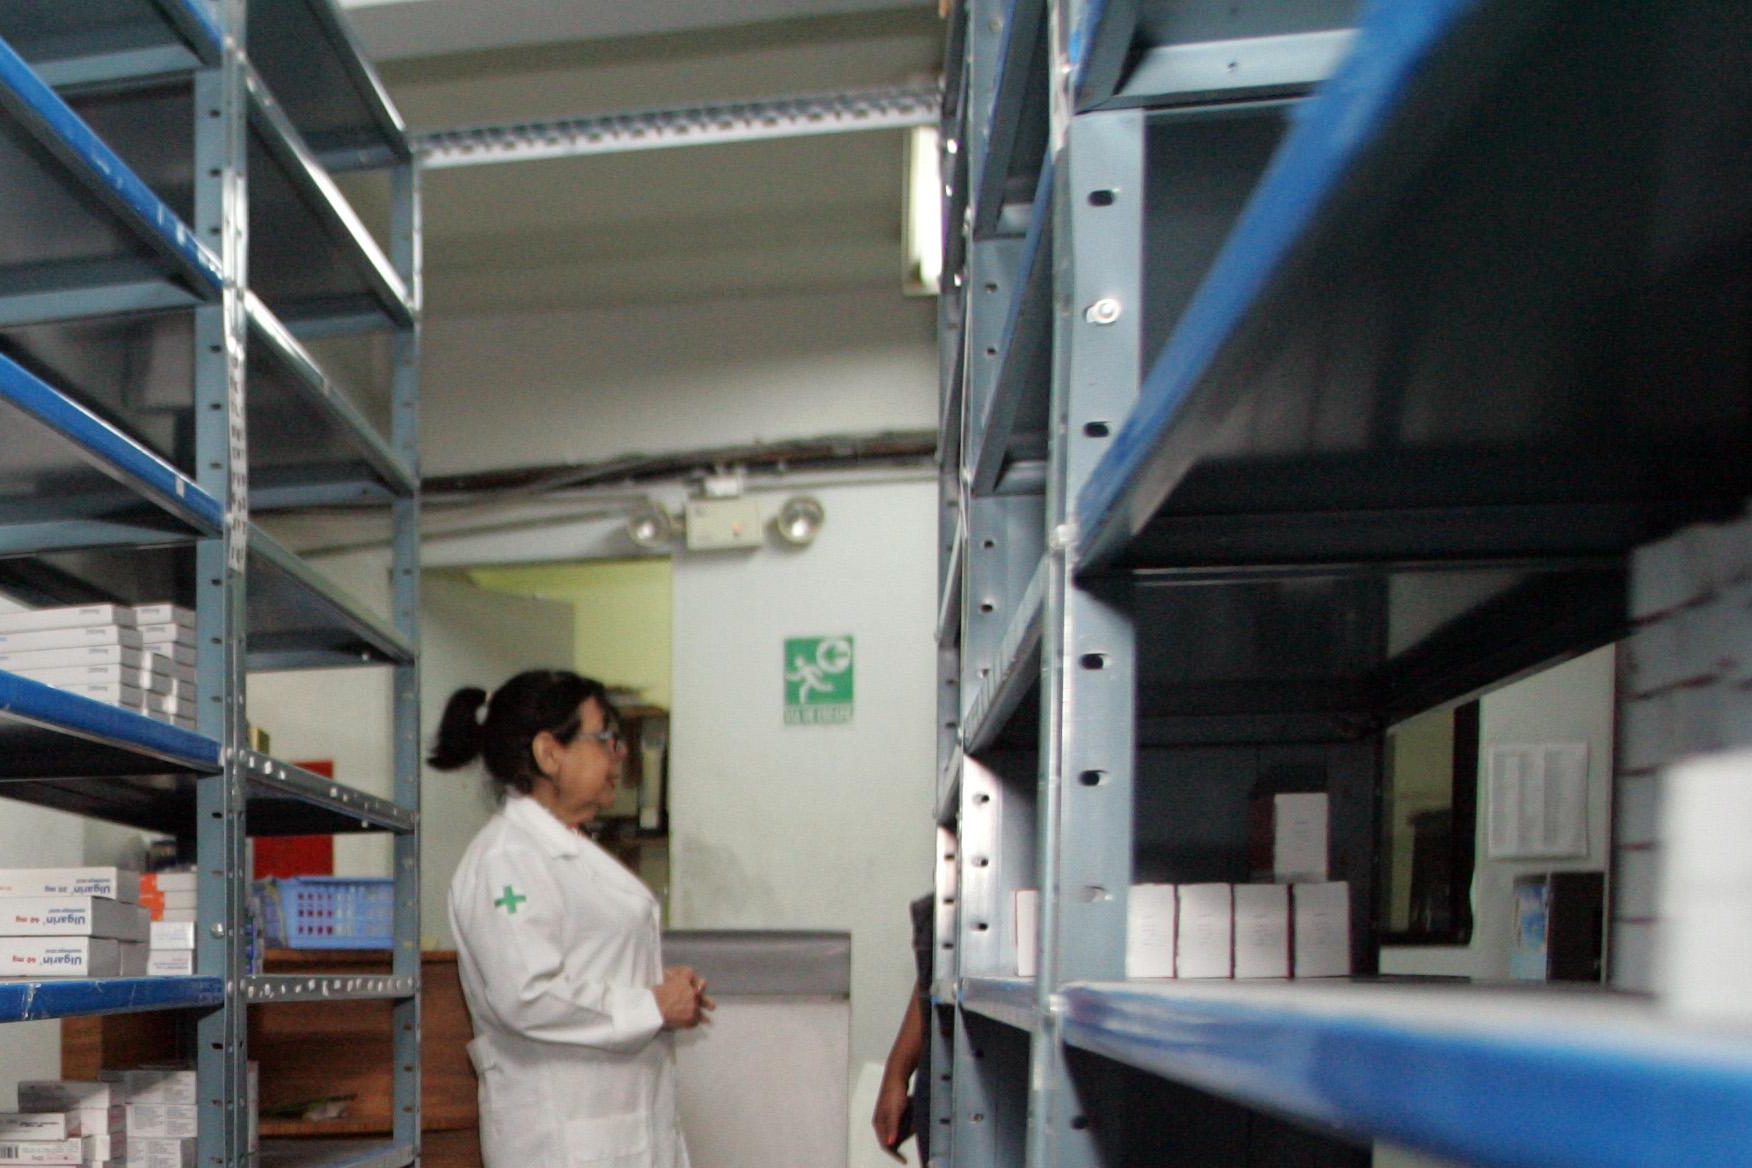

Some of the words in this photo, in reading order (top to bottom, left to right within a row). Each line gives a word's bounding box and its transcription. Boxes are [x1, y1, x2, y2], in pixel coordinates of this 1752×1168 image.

[74, 885, 111, 895] Ulgarin
[46, 914, 86, 925] Ulgarin
[42, 955, 82, 965] Ulgarin
